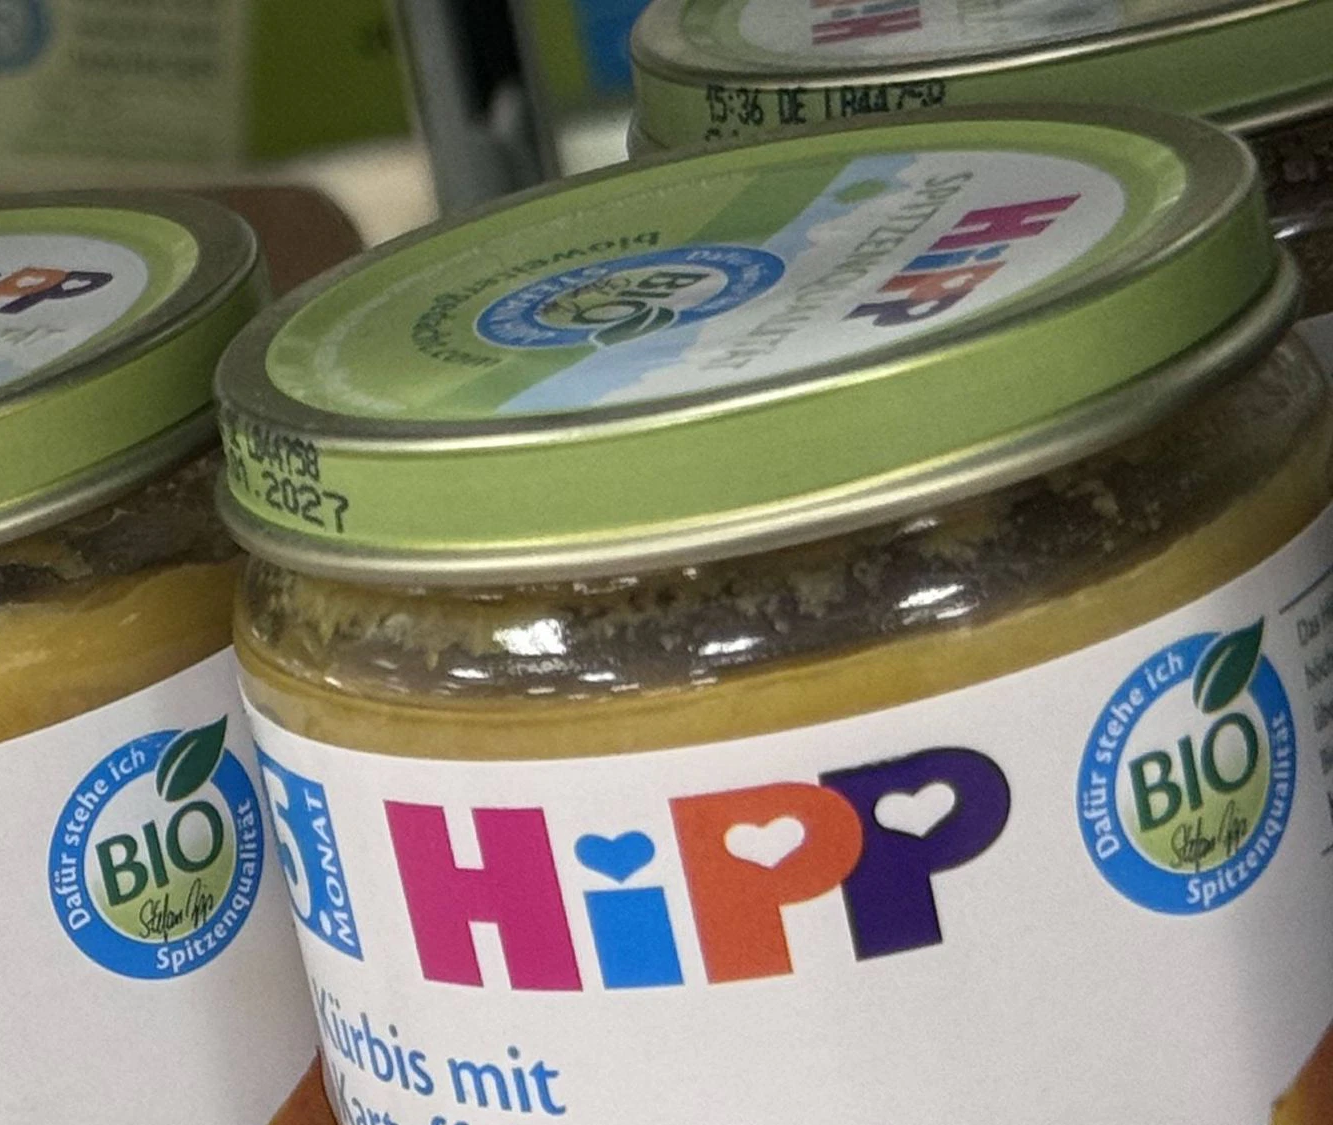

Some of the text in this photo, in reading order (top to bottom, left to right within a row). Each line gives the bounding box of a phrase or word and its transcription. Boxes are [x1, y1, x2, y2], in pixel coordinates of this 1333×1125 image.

[778, 87, 806, 126] DE
[569, 271, 712, 326] BIO
[841, 192, 1082, 327] HiPP
[1083, 652, 1183, 861] Dafür stehe ich
[1129, 711, 1259, 833] BIO
[54, 748, 146, 931] Dafür stehe ich
[95, 800, 224, 907] BIO
[156, 799, 257, 973] Spitzenqualität
[303, 787, 357, 948] MONAT
[383, 746, 1011, 992] HiPP
[311, 978, 567, 1116] Kürbis mit
